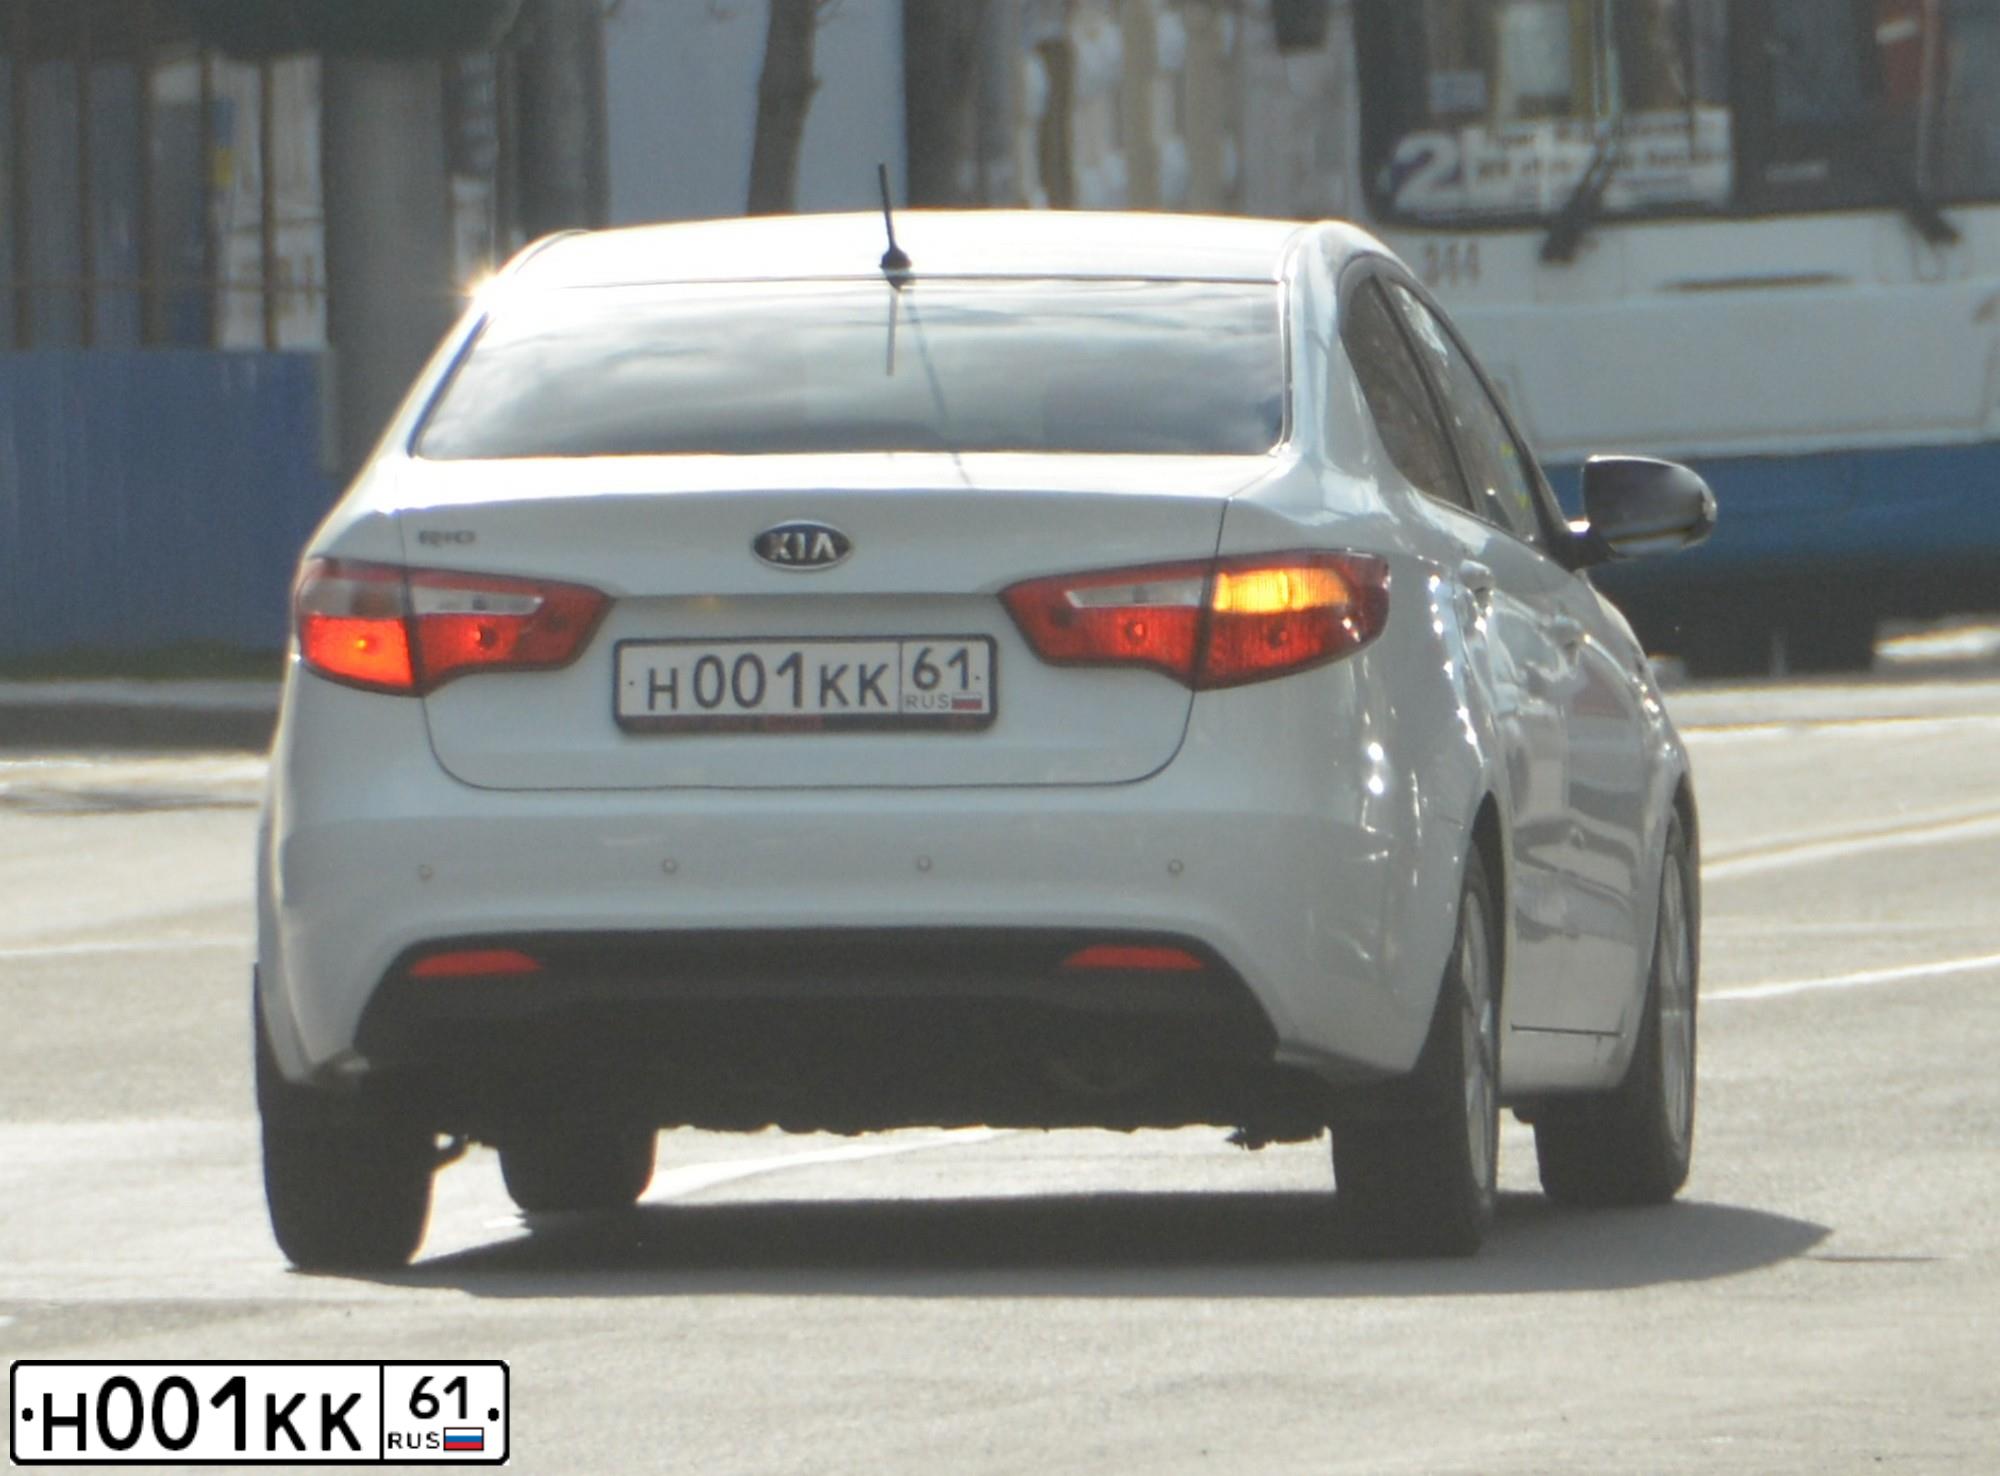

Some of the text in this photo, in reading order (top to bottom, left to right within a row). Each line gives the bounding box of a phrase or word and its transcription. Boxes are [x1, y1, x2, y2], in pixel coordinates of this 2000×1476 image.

[768, 531, 838, 561] KIA
[646, 646, 969, 711] H001KK 61
[903, 693, 951, 711] RUS
